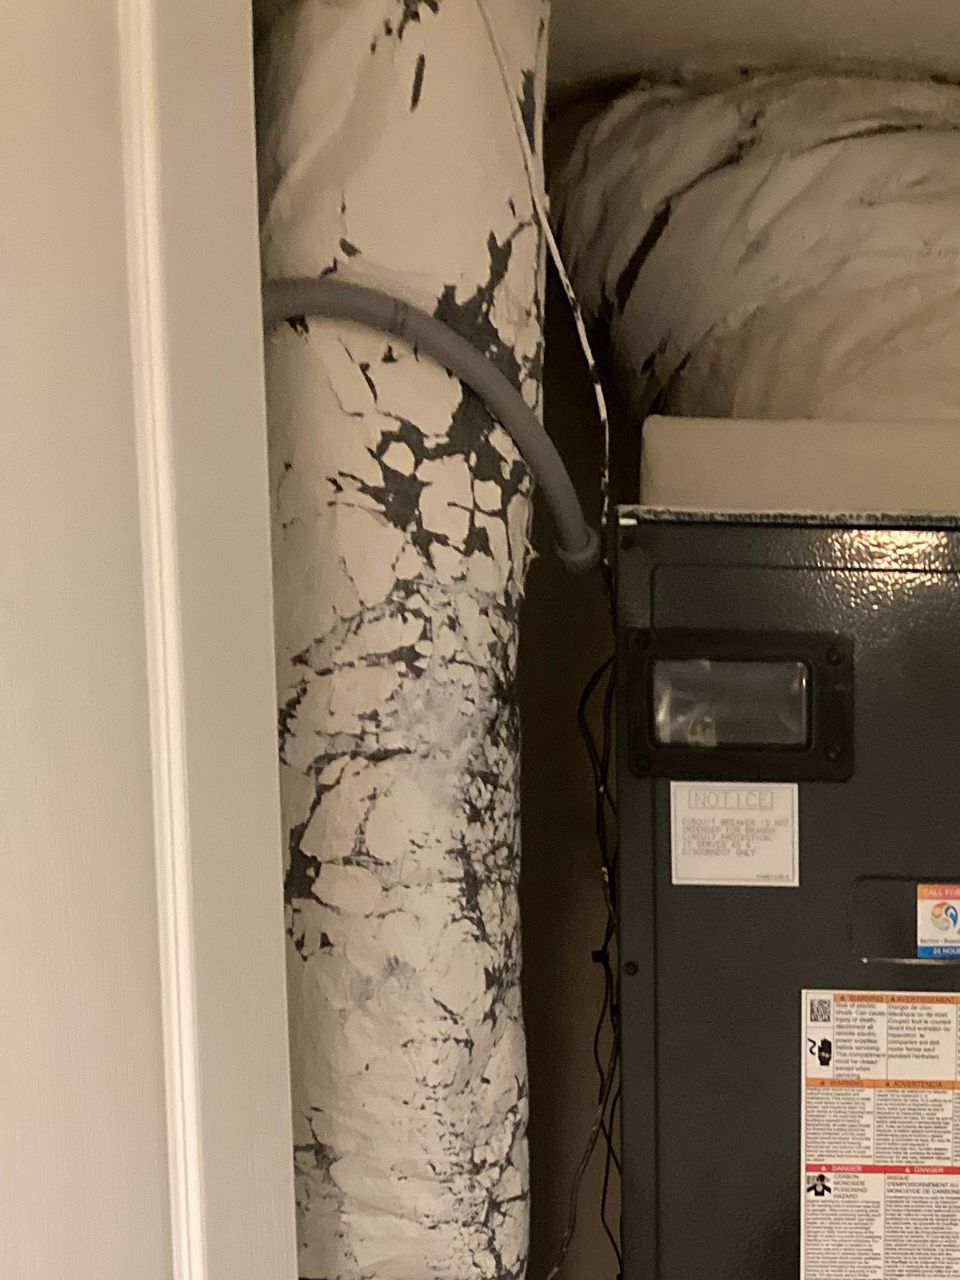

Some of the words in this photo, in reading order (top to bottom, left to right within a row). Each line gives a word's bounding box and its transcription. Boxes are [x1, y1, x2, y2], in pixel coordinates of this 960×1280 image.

[694, 792, 768, 807] NOTICE
[682, 818, 716, 826] CIRCUIT
[736, 848, 756, 856] ONLY
